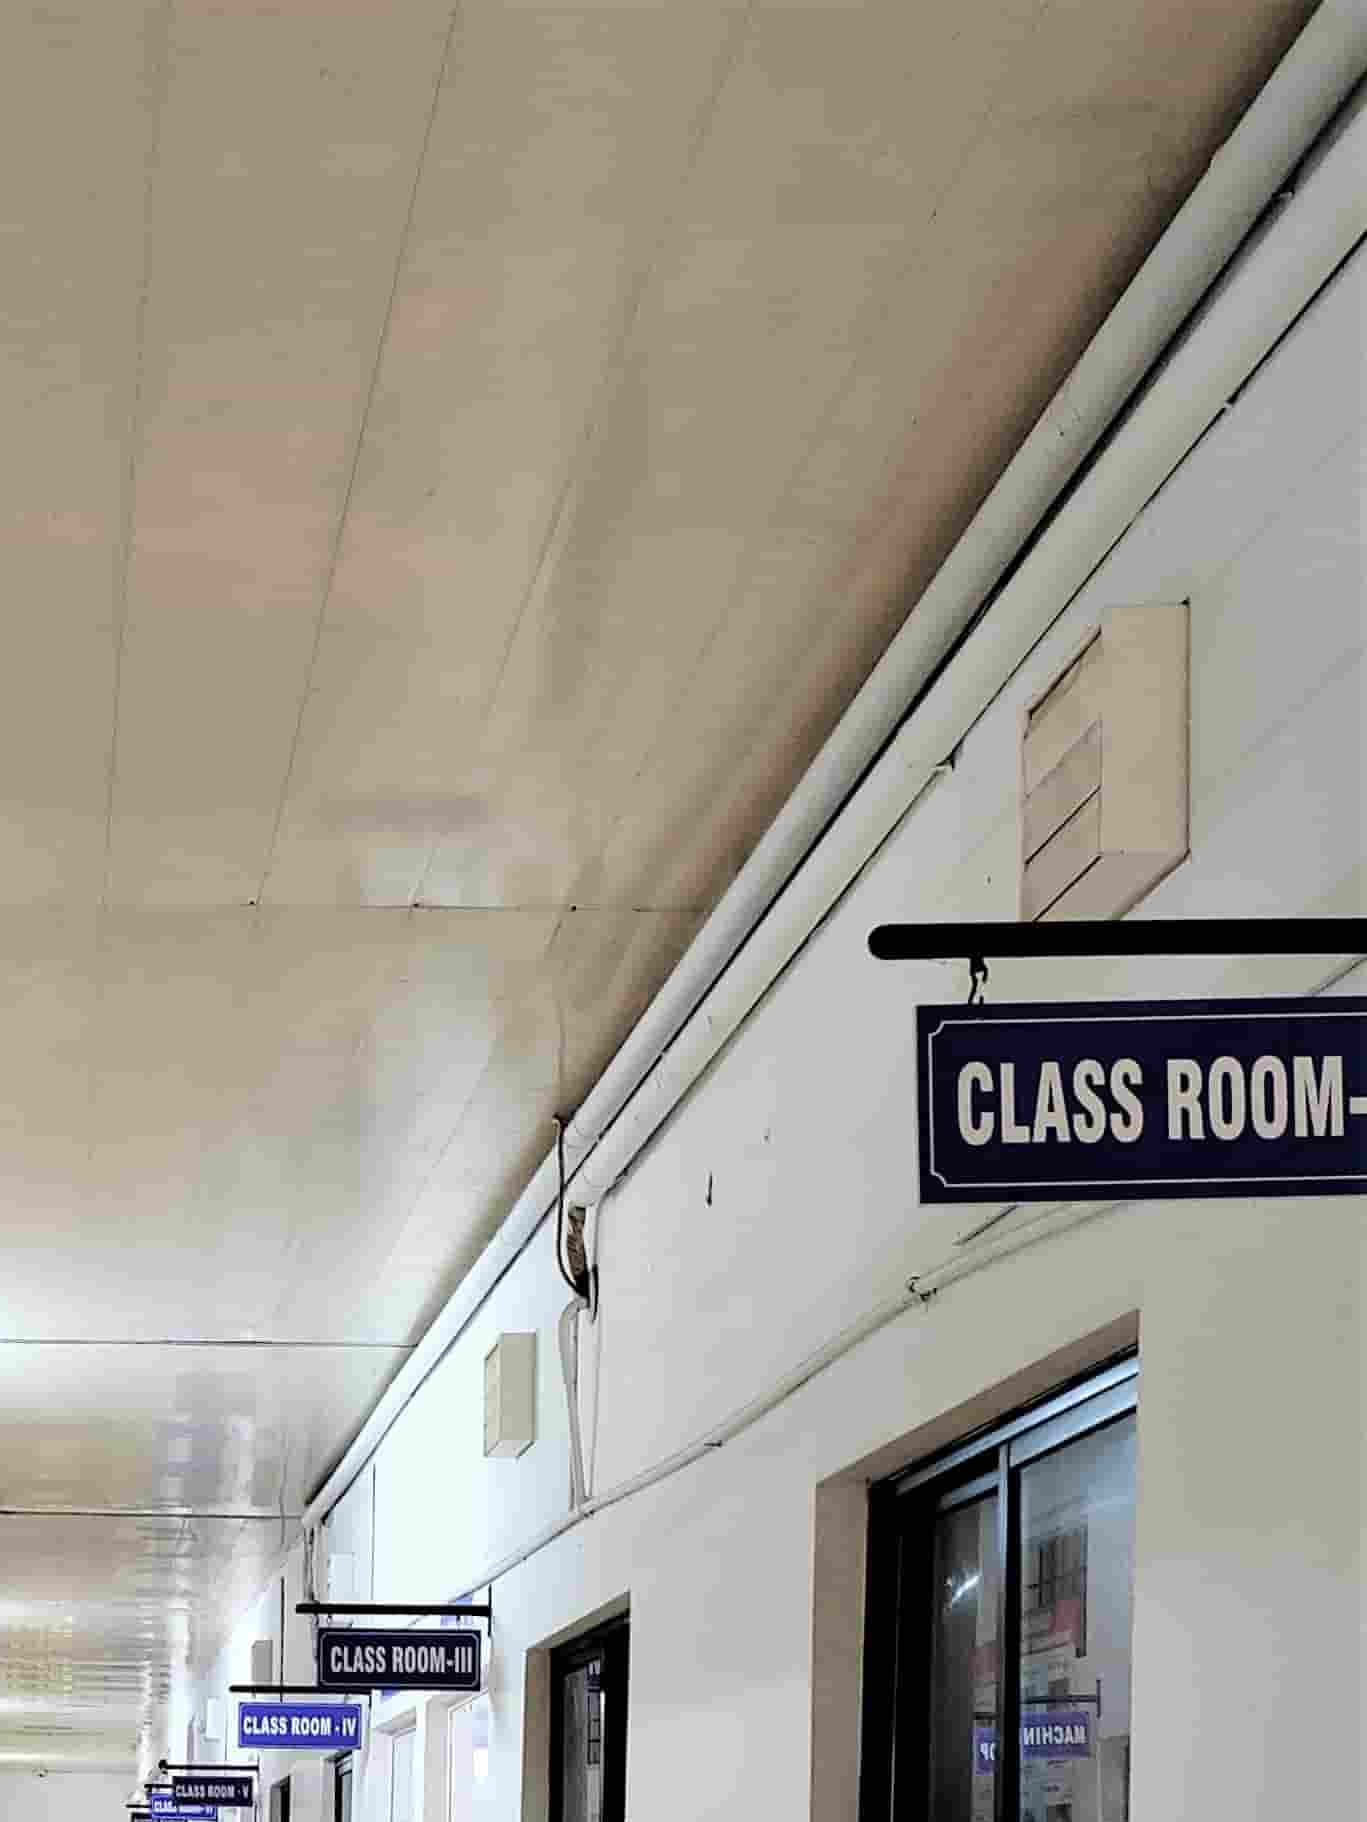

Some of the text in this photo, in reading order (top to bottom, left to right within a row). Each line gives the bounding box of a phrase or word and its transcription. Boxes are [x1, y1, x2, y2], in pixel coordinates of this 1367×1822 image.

[957, 1057, 1144, 1146] CLASS
[332, 1646, 386, 1673] CLASS
[243, 1716, 287, 1736] CLASS
[291, 1717, 331, 1736] ROOM
[342, 1717, 356, 1737] IV
[175, 1783, 205, 1799] CLASS
[208, 1784, 234, 1799] ROOM
